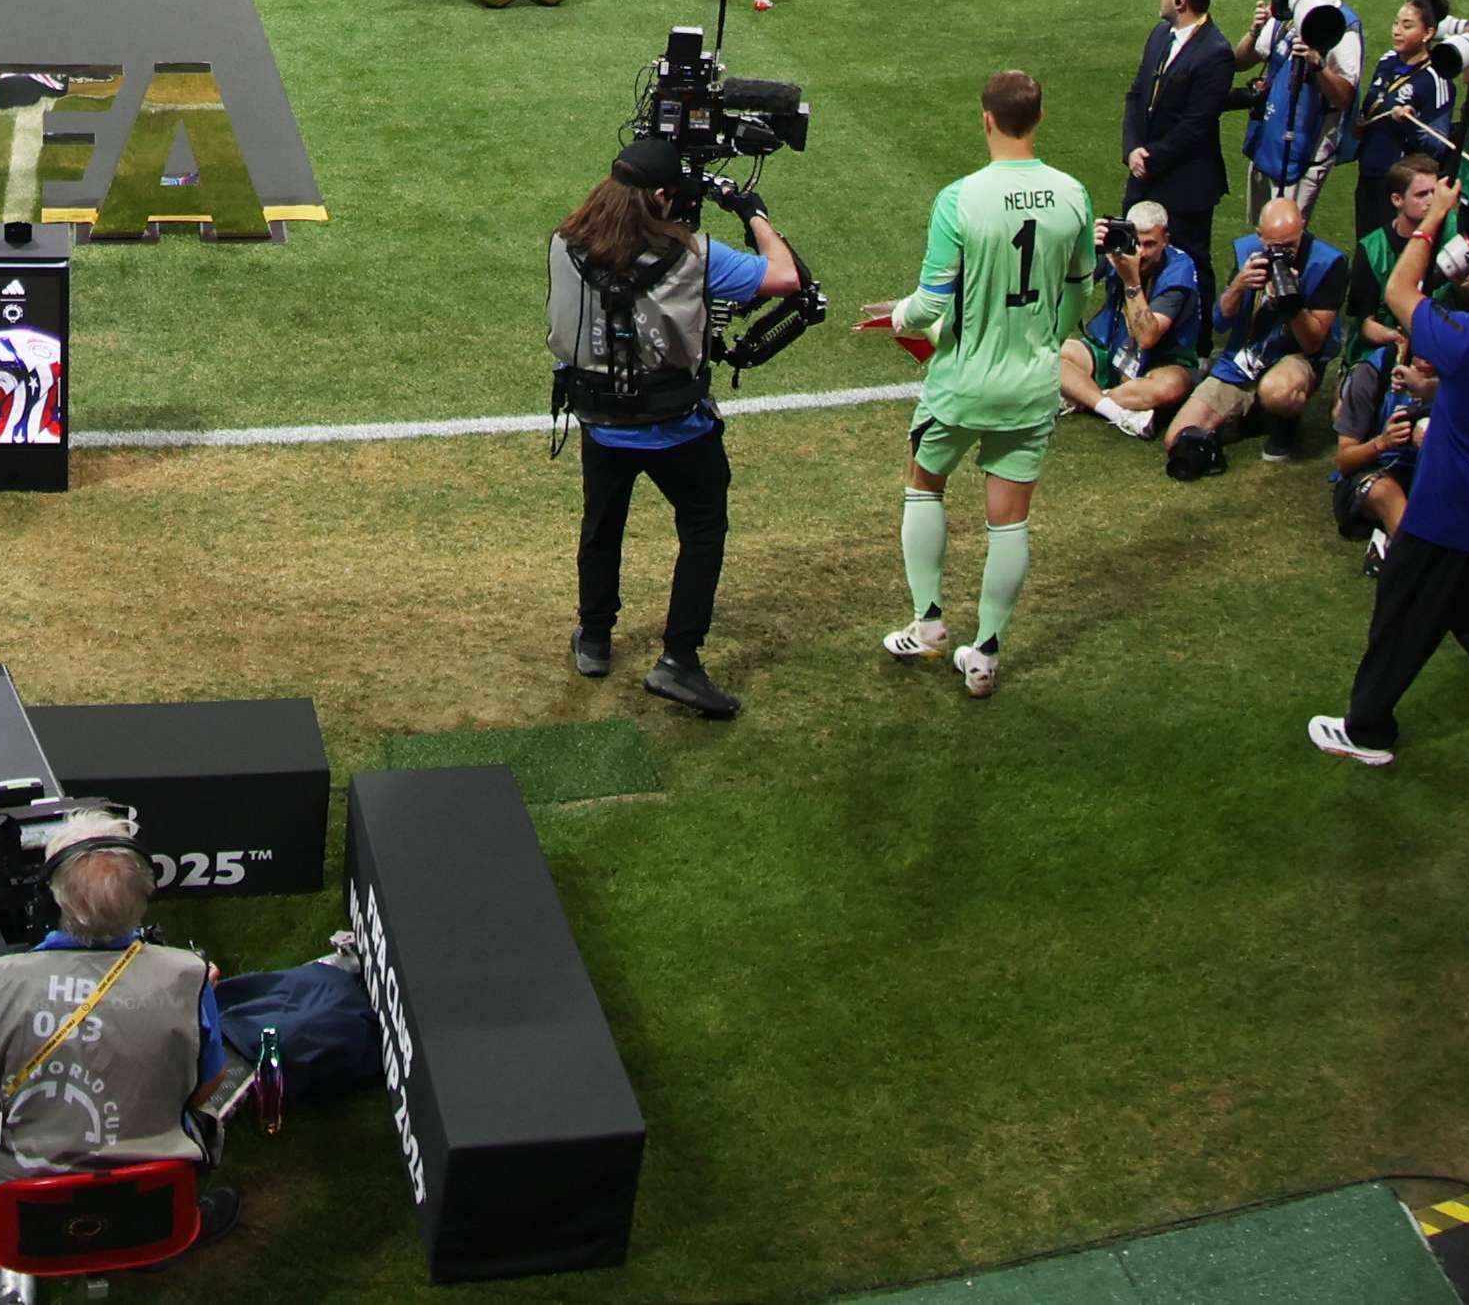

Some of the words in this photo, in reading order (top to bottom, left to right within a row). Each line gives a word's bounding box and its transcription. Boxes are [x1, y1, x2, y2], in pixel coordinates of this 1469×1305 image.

[1004, 190, 1056, 212] NEUER
[1005, 218, 1040, 308] 1
[48, 974, 99, 1005] HB
[386, 966, 413, 1078] CLUB
[103, 1100, 120, 1147] CUP
[394, 1085, 427, 1205] 2025
